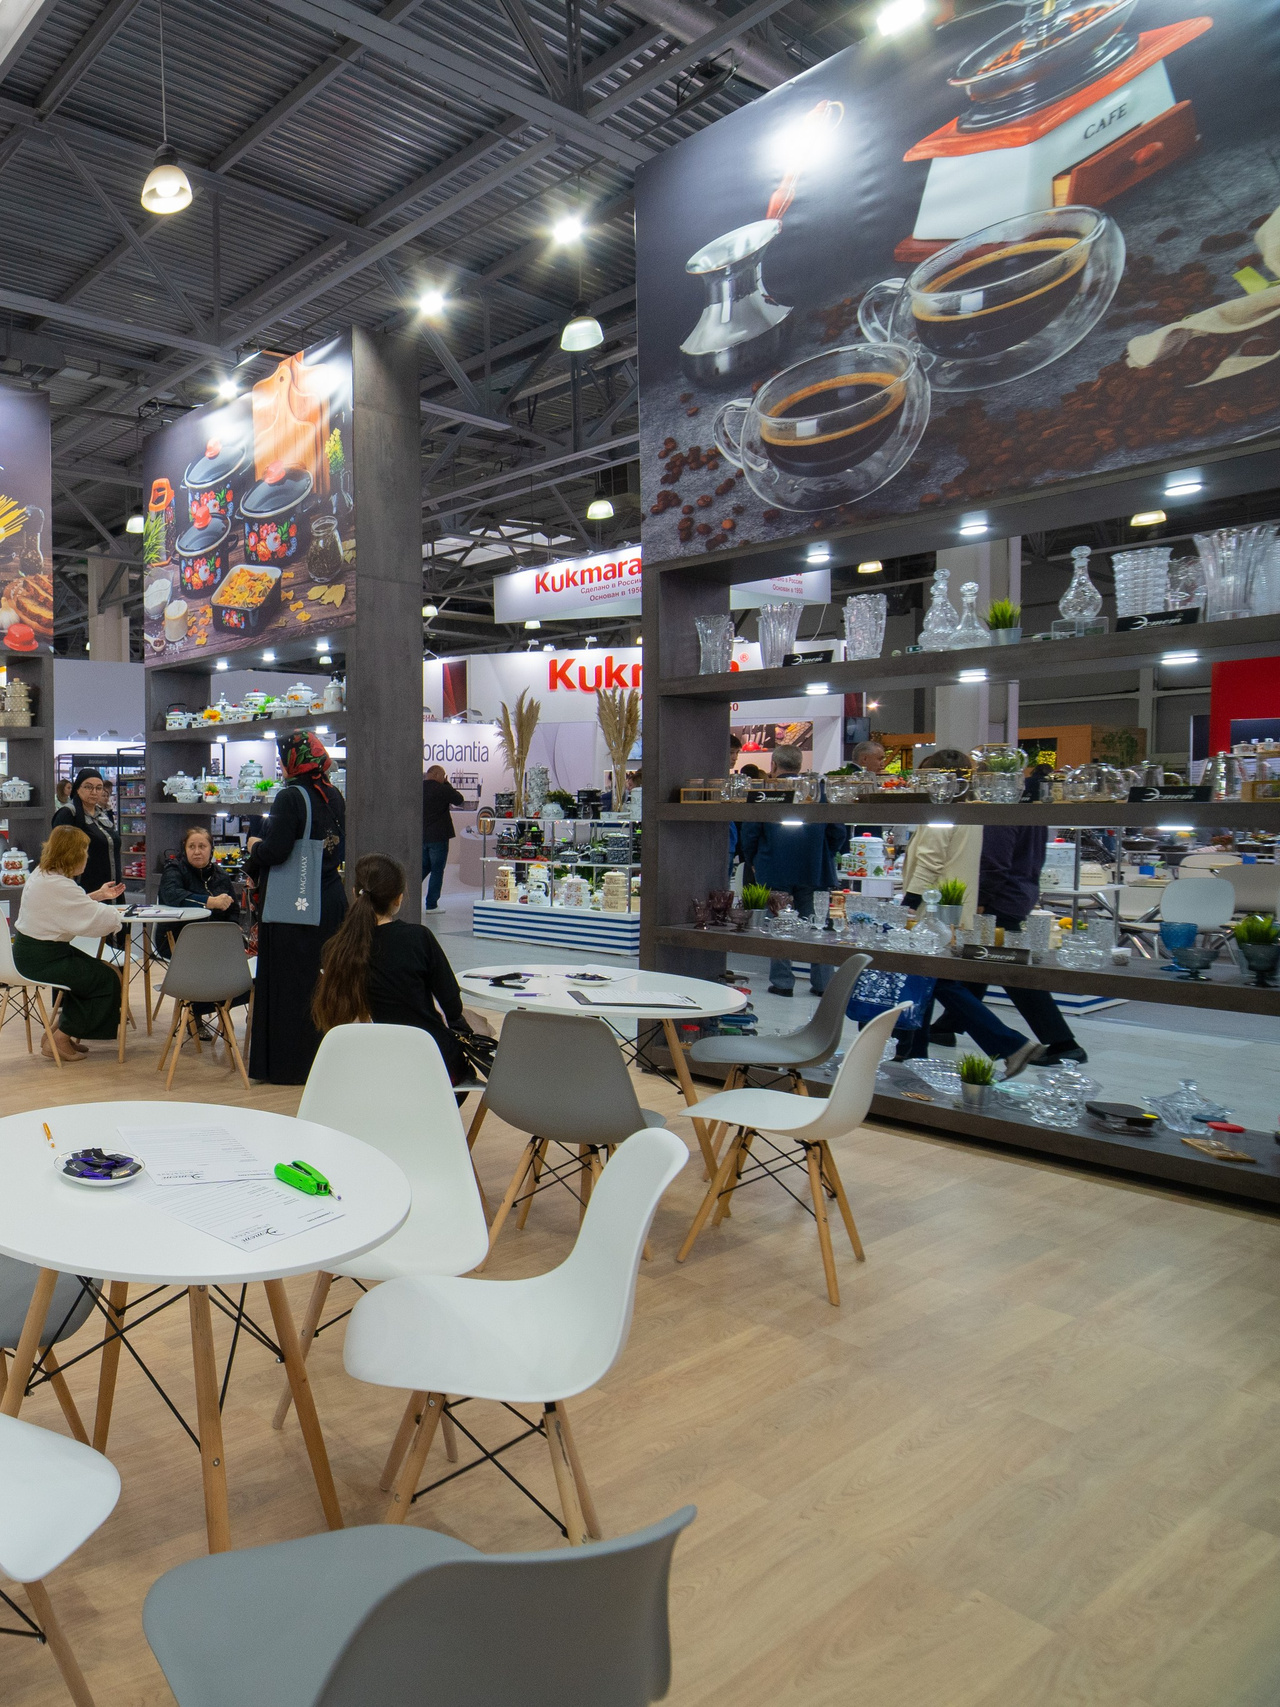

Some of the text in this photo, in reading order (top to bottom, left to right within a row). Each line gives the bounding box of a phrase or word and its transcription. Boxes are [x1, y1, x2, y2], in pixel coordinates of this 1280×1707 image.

[1084, 103, 1127, 139] CAFE
[535, 556, 642, 594] Kukmara
[581, 584, 610, 594] Сделано
[589, 592, 619, 602] Основан
[423, 739, 489, 762] brabantia
[300, 855, 308, 894] MAGAMAX
